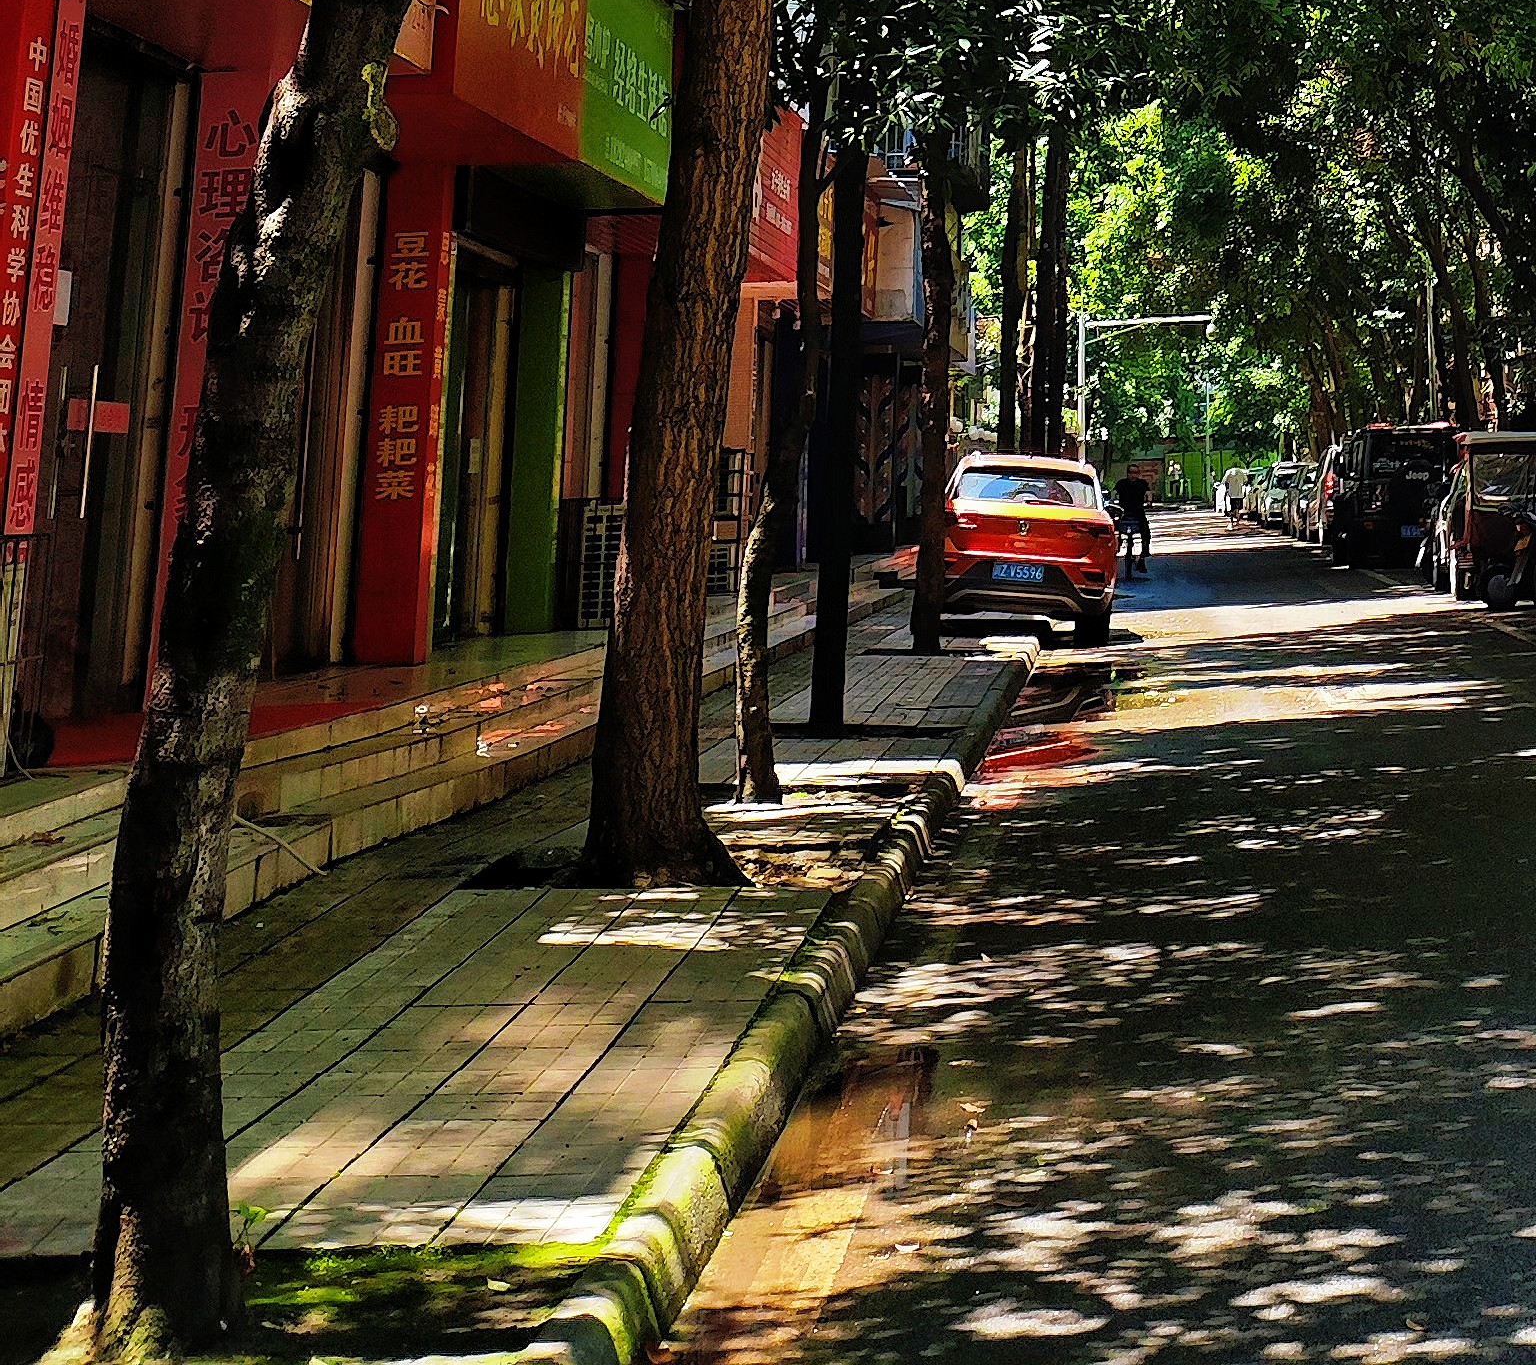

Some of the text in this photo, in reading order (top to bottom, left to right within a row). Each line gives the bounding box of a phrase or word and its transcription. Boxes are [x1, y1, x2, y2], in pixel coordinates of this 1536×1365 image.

[388, 230, 430, 291] 豆花
[383, 316, 425, 377] 血旺
[9, 379, 45, 530] 情感
[1405, 470, 1430, 481] Jeep
